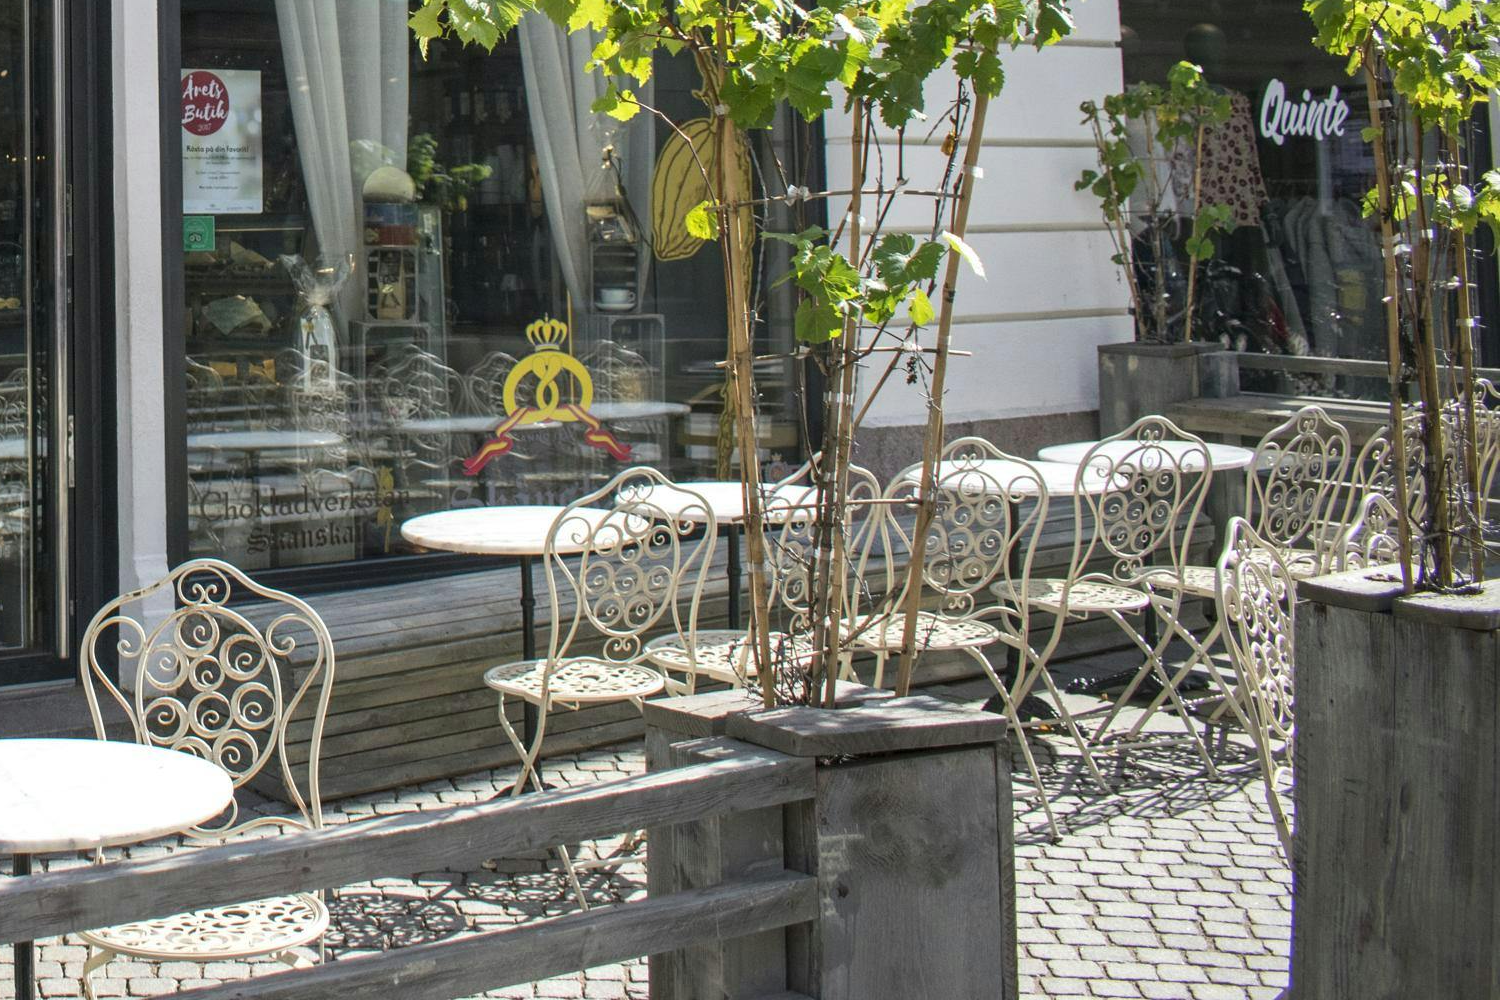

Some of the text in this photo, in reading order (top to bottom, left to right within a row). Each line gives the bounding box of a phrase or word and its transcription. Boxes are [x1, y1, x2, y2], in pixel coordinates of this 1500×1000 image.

[182, 74, 224, 100] Årets
[181, 99, 228, 124] Butik
[1260, 78, 1349, 146] Quinte
[205, 145, 214, 153] på
